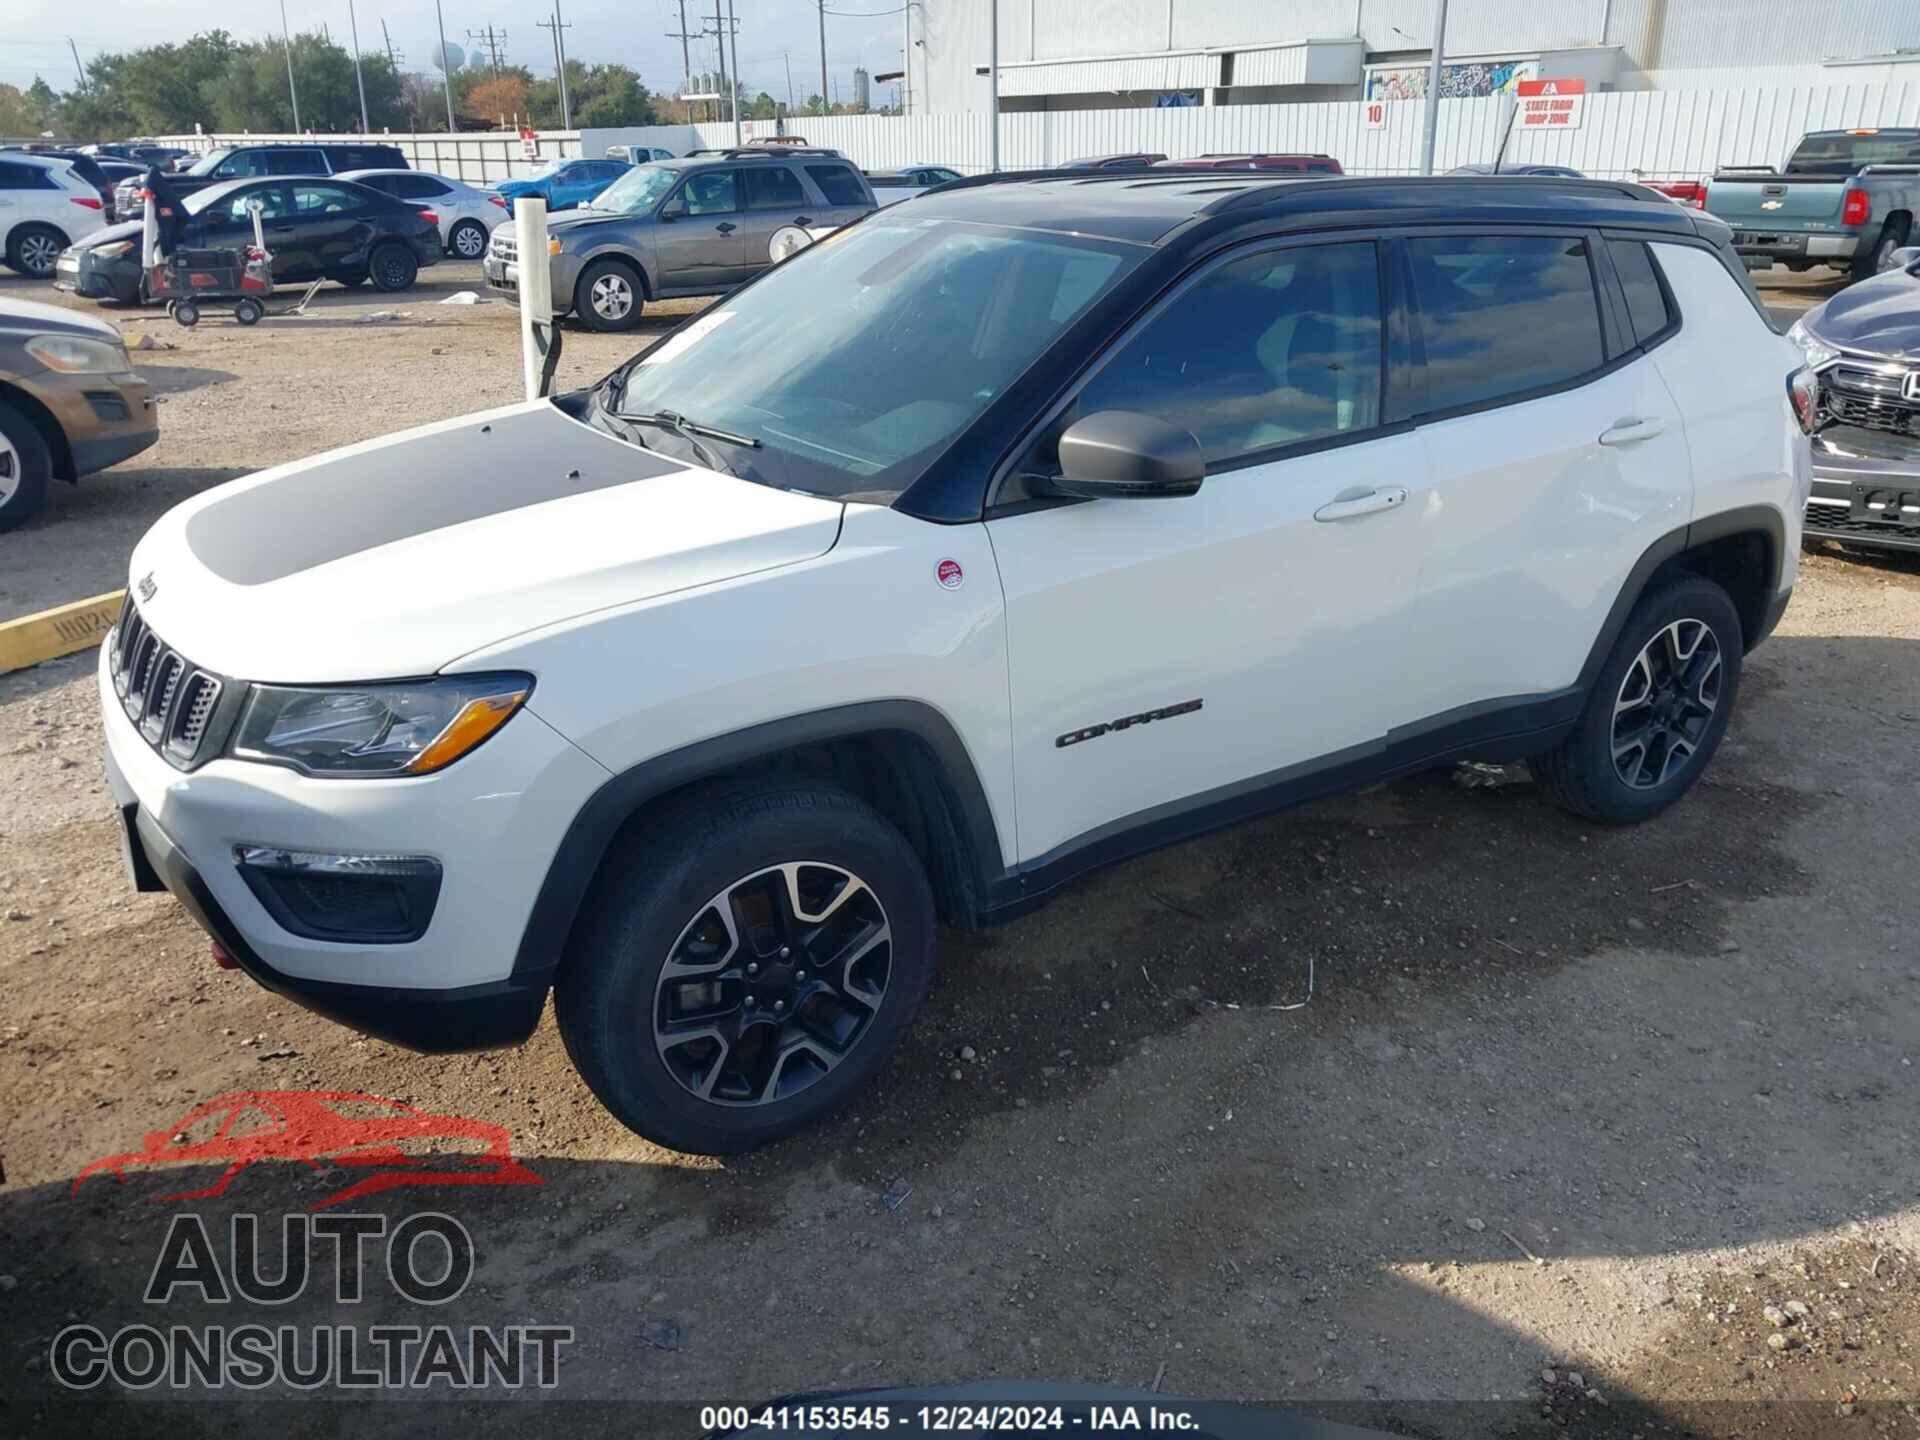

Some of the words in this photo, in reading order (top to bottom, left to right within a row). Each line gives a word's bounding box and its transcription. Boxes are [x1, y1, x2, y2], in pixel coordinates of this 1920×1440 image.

[1368, 104, 1382, 123] 10
[1526, 100, 1549, 111] STATE
[1055, 698, 1204, 748] COMPASS
